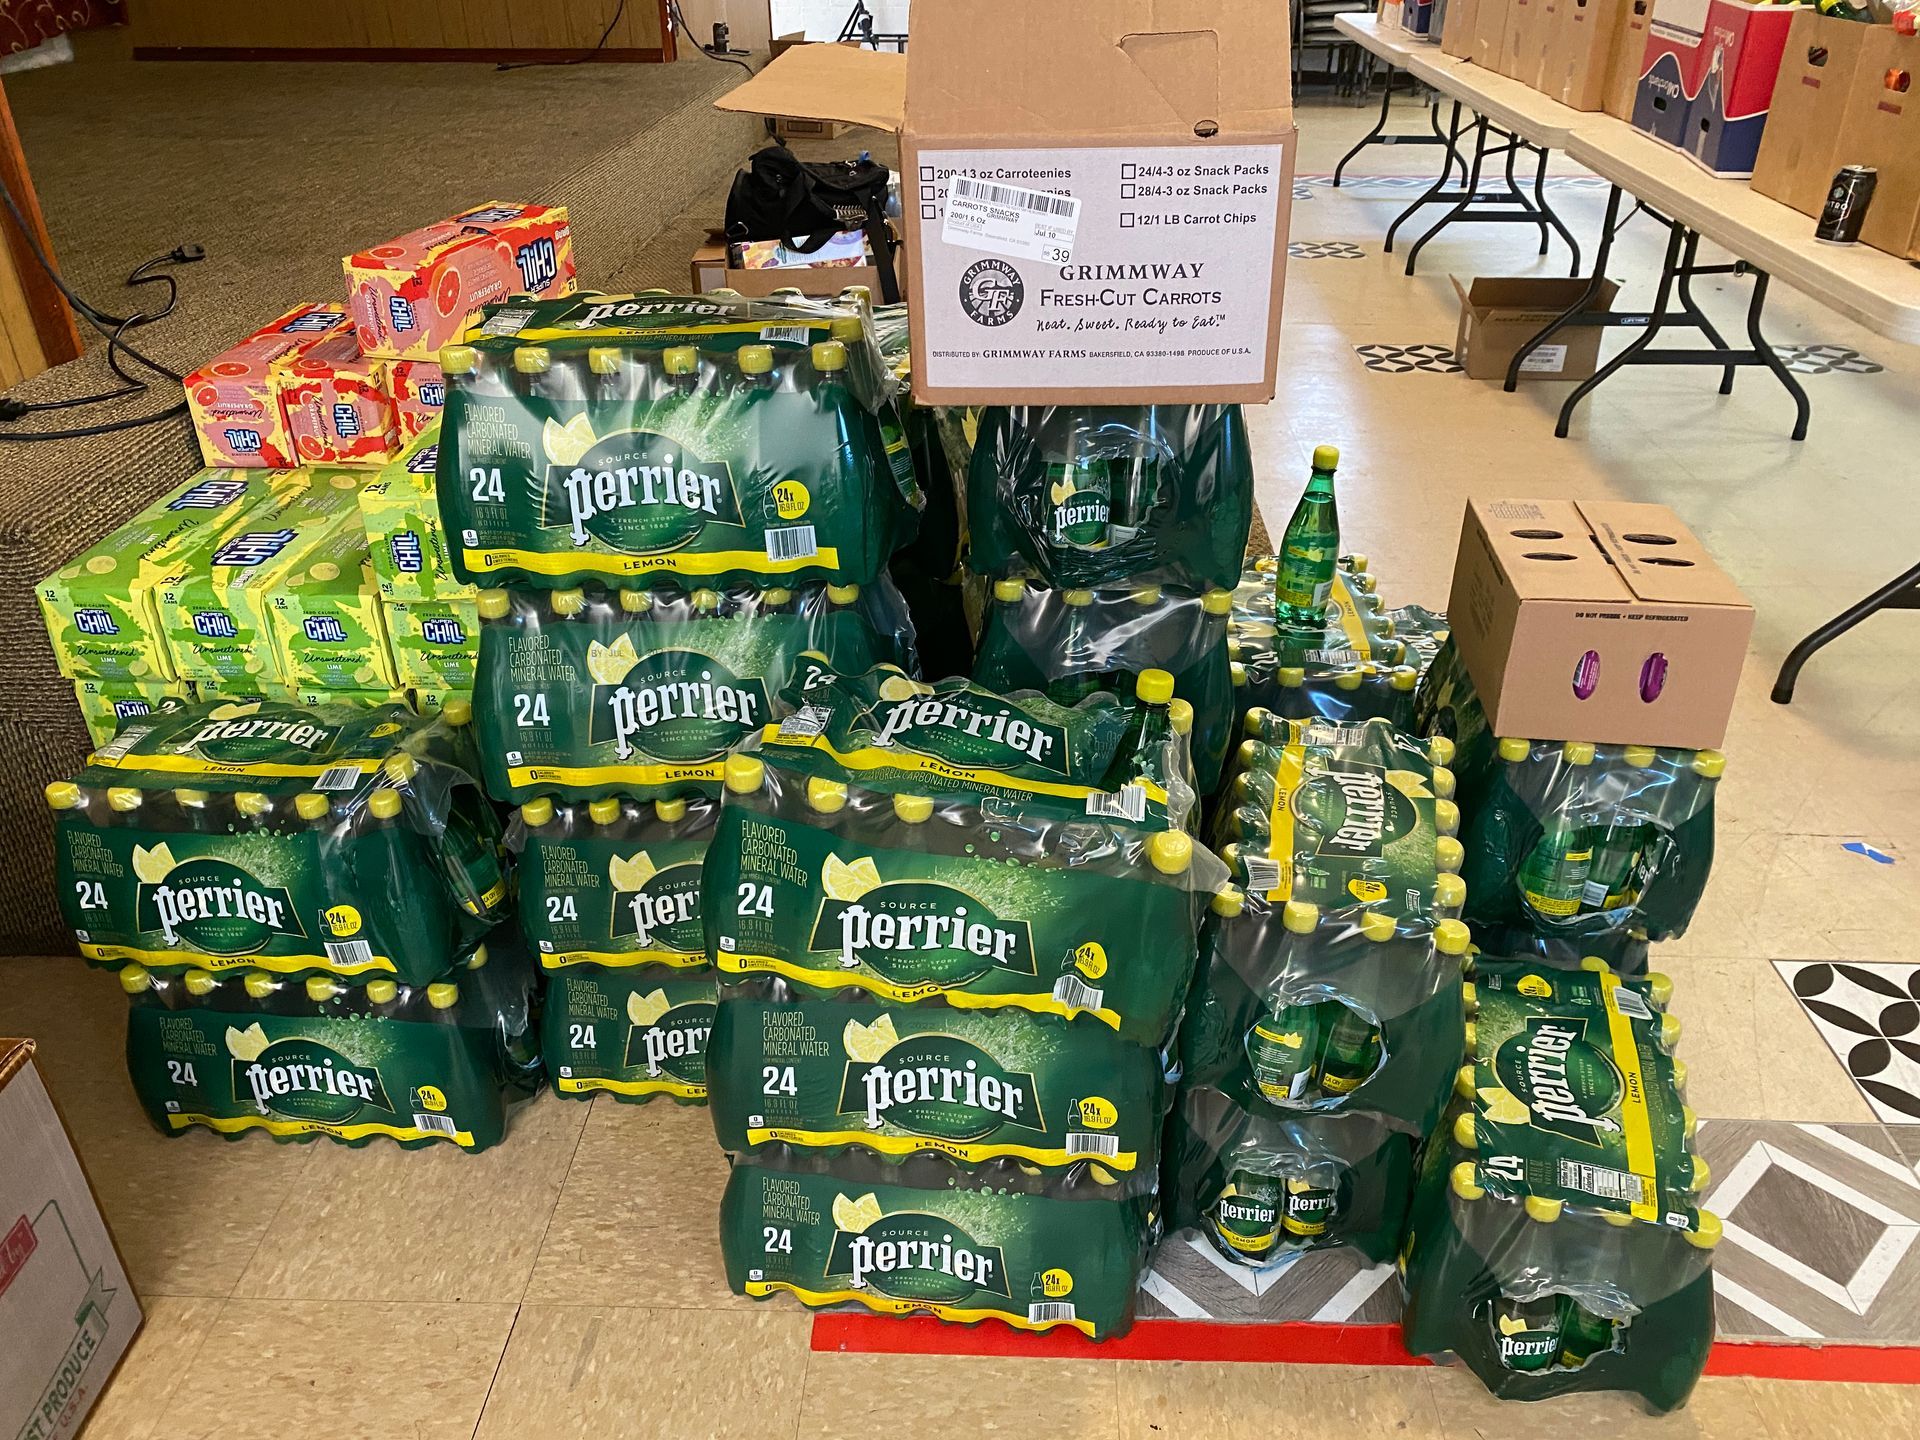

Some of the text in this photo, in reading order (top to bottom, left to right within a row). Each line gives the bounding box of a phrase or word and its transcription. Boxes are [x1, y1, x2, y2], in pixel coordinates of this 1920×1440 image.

[937, 168, 1071, 179] 200-13 oz Carroteenies
[1138, 164, 1269, 177] 24/4-3 oz Snack Packs
[1138, 184, 1267, 196] 28/4-3 oz Snack Packs
[950, 212, 975, 222] 200/16
[952, 200, 1020, 219] CARROTS SNACKS
[1138, 213, 1256, 225] 12/1 LB Carrot Chips
[1035, 230, 1046, 238] Jul
[1052, 248, 1070, 262] 39
[963, 261, 1021, 286] GRIMMWAY
[1059, 263, 1204, 280] GRIMMWAY
[1040, 289, 1221, 306] FRESH-CUT CARROTS
[971, 310, 1014, 325] FARMS
[1125, 318, 1167, 333] Ready
[1173, 317, 1187, 328] to
[983, 350, 1045, 358] GRIMMWAY
[1049, 349, 1086, 358] FARMS
[464, 403, 505, 423] FLAVORED
[467, 422, 518, 441] CARBONATED
[467, 438, 532, 459] MINERAL WATER
[598, 452, 648, 466] SOURCE
[470, 467, 505, 503] 24
[563, 453, 721, 546] perrier
[777, 487, 794, 503] 24x
[624, 558, 677, 570] LEMON
[508, 635, 550, 652] FLAVORED
[510, 649, 562, 667] CARBONATED
[510, 665, 576, 682] MINERAL WATER
[640, 669, 687, 684] SOURCE
[514, 693, 550, 727] 24
[608, 669, 757, 760] perrier
[175, 719, 329, 754] perrier
[871, 700, 1054, 762] perrier
[203, 765, 245, 773] LEMON
[665, 768, 715, 780] LEMON
[920, 761, 976, 779] LEMON
[902, 770, 1033, 802] CARBONATED MINERAL WATER
[1277, 787, 1288, 812] LEMON
[1305, 766, 1395, 852] perrier
[67, 830, 101, 847] FLAVORED
[742, 820, 786, 845] FLAVORED
[71, 845, 113, 862] CARBONATED
[541, 845, 577, 861] FLAVORED
[741, 838, 798, 866] CARBONATED
[72, 859, 124, 878] MINERAL WATER
[544, 859, 588, 875] CARBONATED
[740, 854, 808, 888] MINERAL WATER
[179, 874, 220, 885] SOURCE
[544, 873, 600, 888] MINERAL WATER
[76, 881, 108, 910] 24
[737, 882, 774, 918] 24
[152, 878, 284, 947] perrier
[546, 895, 578, 923] 24
[880, 901, 938, 911] SOURCE
[836, 903, 1016, 968] perrier
[210, 957, 256, 967] LEMON
[566, 977, 598, 993] FLAVORED
[892, 985, 944, 999] LEMO
[568, 991, 609, 1007] CARBONATED
[568, 1004, 618, 1019] MINERAL WATER
[763, 1011, 804, 1026] FLAVORED
[159, 1017, 193, 1030] FLAVORED
[161, 1029, 205, 1044] CARBONATED
[569, 1024, 596, 1049] 24
[763, 1026, 816, 1041] CARBONATED
[162, 1040, 217, 1057] MINERAL WATER
[763, 1042, 830, 1057] MINERAL WATER
[271, 1054, 311, 1063] SOURCE
[899, 1054, 950, 1064] SOURCE
[168, 1060, 197, 1087] 24
[762, 1066, 798, 1096] 24
[1516, 1024, 1622, 1132] perrier
[246, 1058, 373, 1115] perrier
[862, 1058, 1023, 1129] perrier
[1628, 1072, 1641, 1103] LEMON
[1083, 1101, 1100, 1116] 24x
[301, 1124, 343, 1137] LEMON
[915, 1140, 970, 1158] LEMON
[1488, 1155, 1524, 1181] 24
[762, 1177, 800, 1194] FLAVORED
[762, 1192, 811, 1211] CARBONATED
[1289, 1194, 1332, 1212] perri
[762, 1206, 821, 1226] MINERAL WATER
[1220, 1200, 1275, 1224] perrier
[763, 1226, 793, 1254] 24
[881, 1228, 929, 1238] SOURCE
[1232, 1235, 1256, 1244] LEMON
[848, 1233, 993, 1288] perrier
[895, 1303, 943, 1315] LEMON
[42, 1329, 96, 1425] PRODUCE
